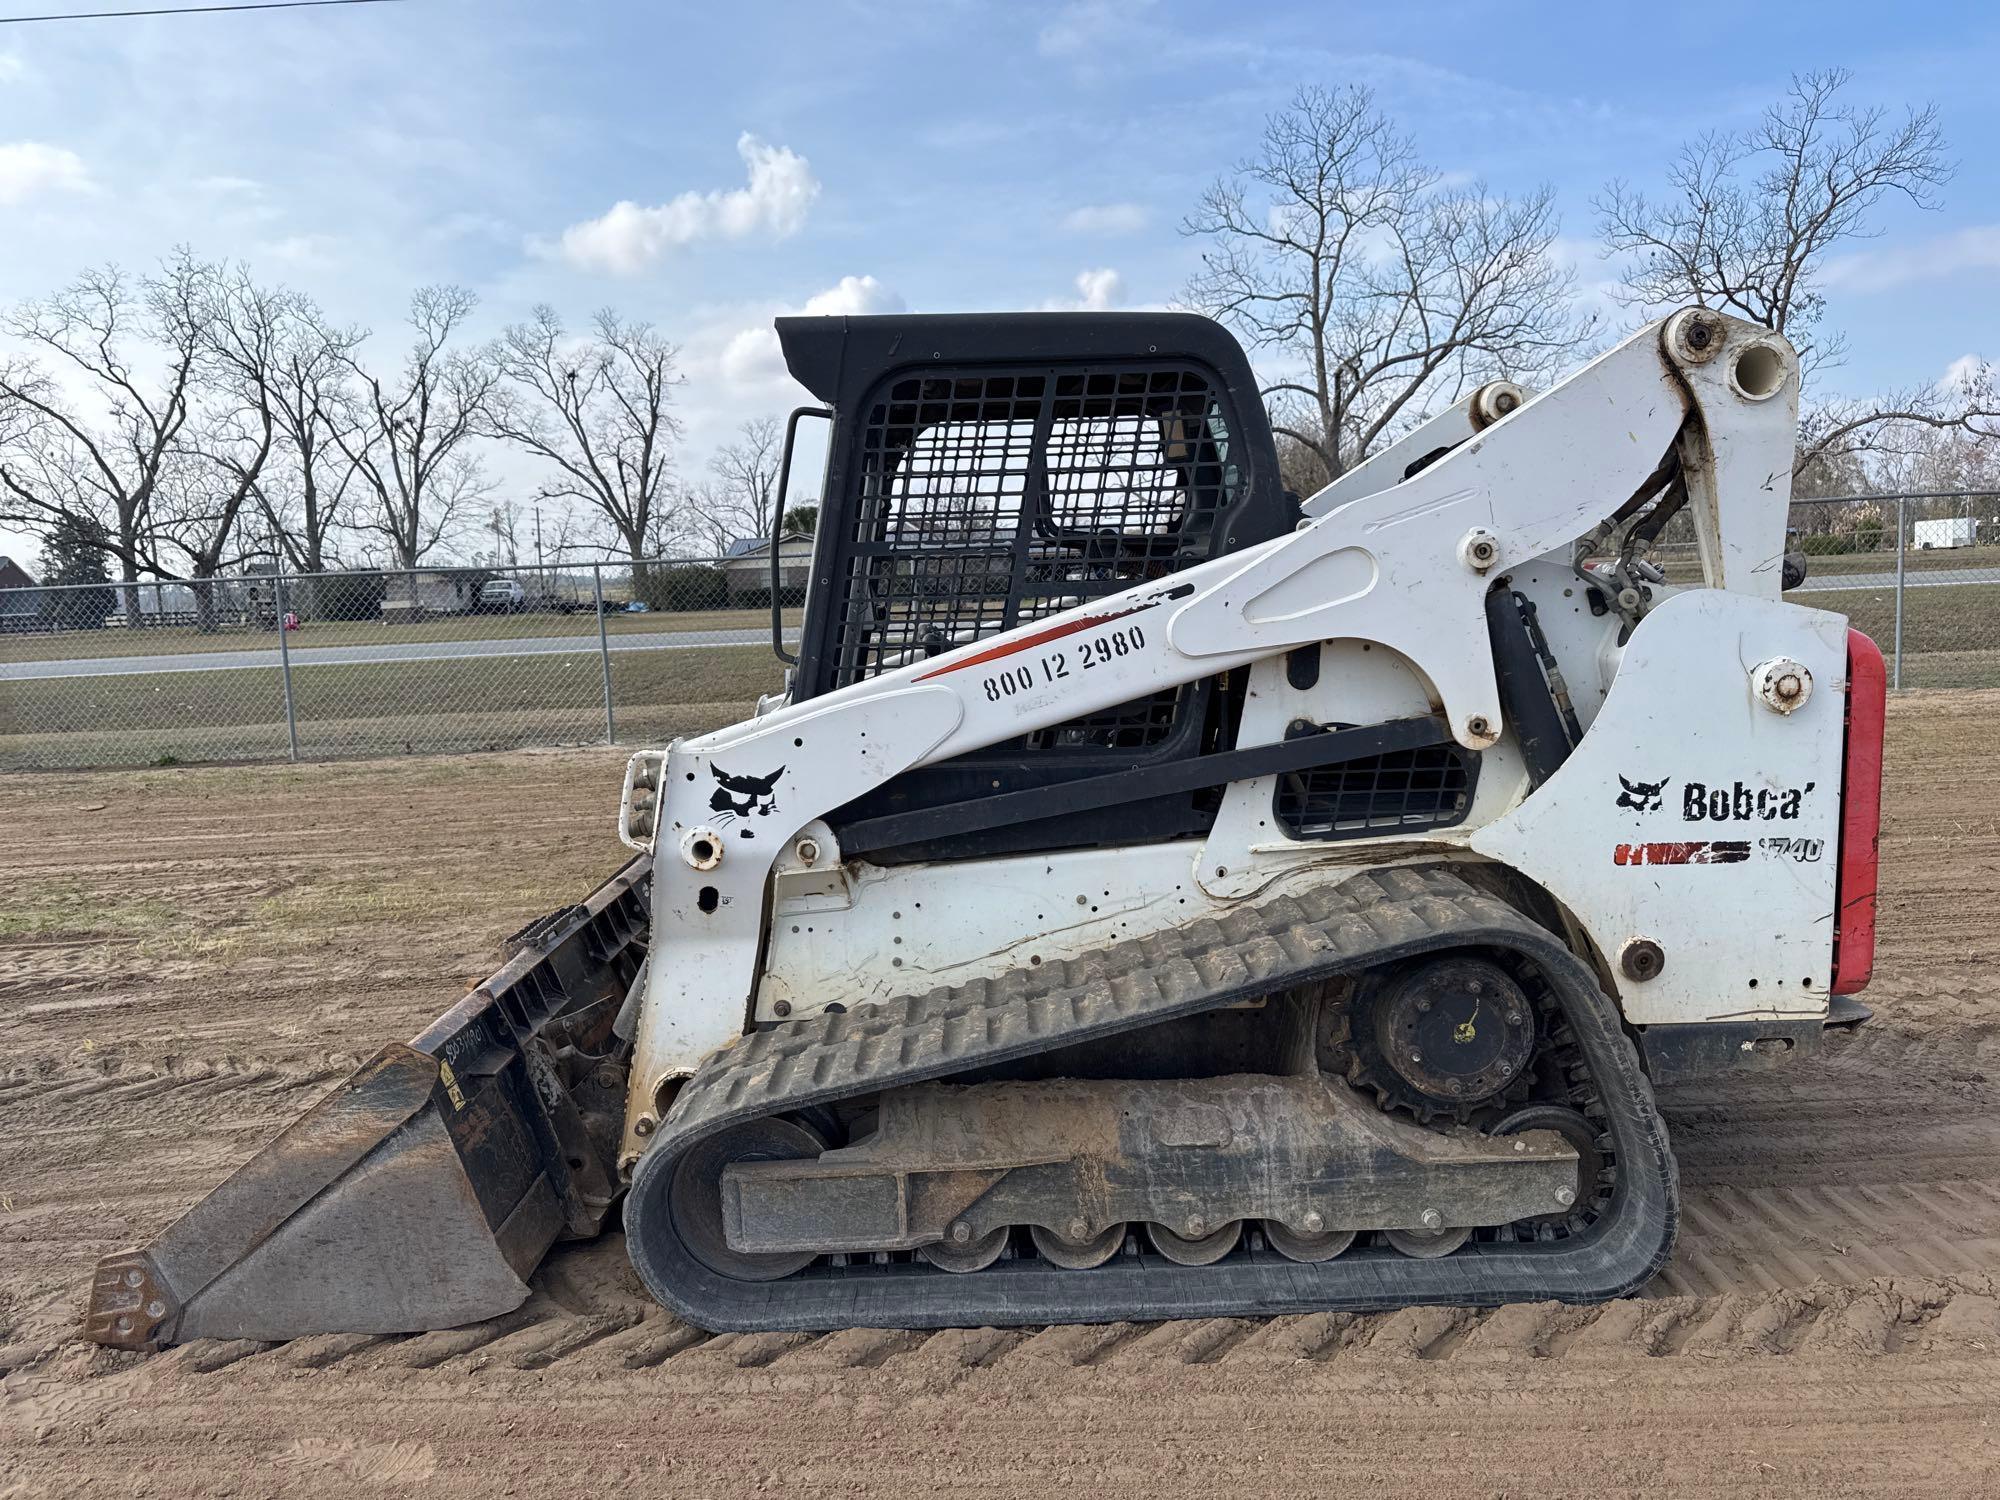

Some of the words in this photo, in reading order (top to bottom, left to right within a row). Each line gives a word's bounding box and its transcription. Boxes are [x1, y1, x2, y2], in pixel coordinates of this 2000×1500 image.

[983, 666, 1033, 702] 800
[1041, 653, 1070, 682] 12
[1078, 625, 1145, 670] 2980
[1683, 781, 1816, 822] Bobca
